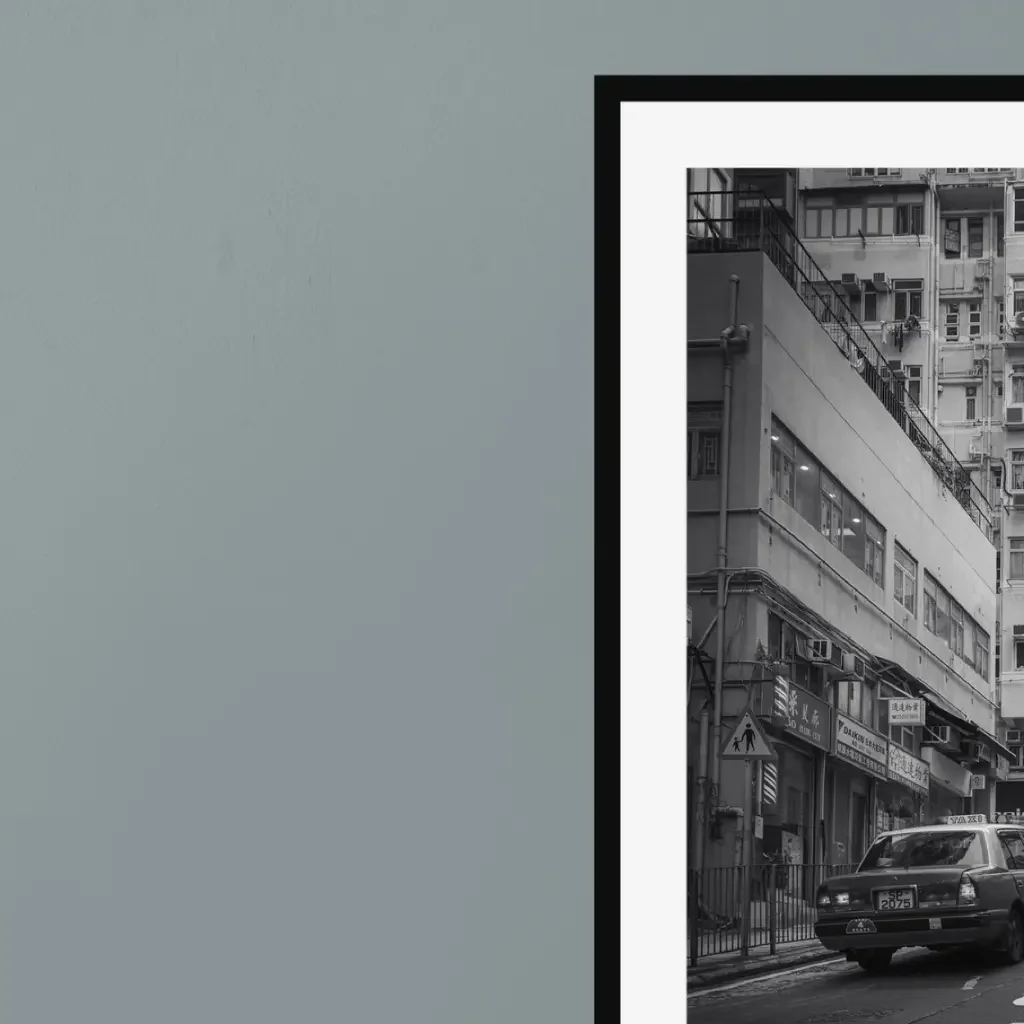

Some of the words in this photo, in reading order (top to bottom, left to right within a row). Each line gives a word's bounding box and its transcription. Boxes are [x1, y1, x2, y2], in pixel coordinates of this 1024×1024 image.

[843, 726, 865, 744] DAIKIN
[950, 815, 983, 825] TAXI
[881, 899, 911, 910] 2075
